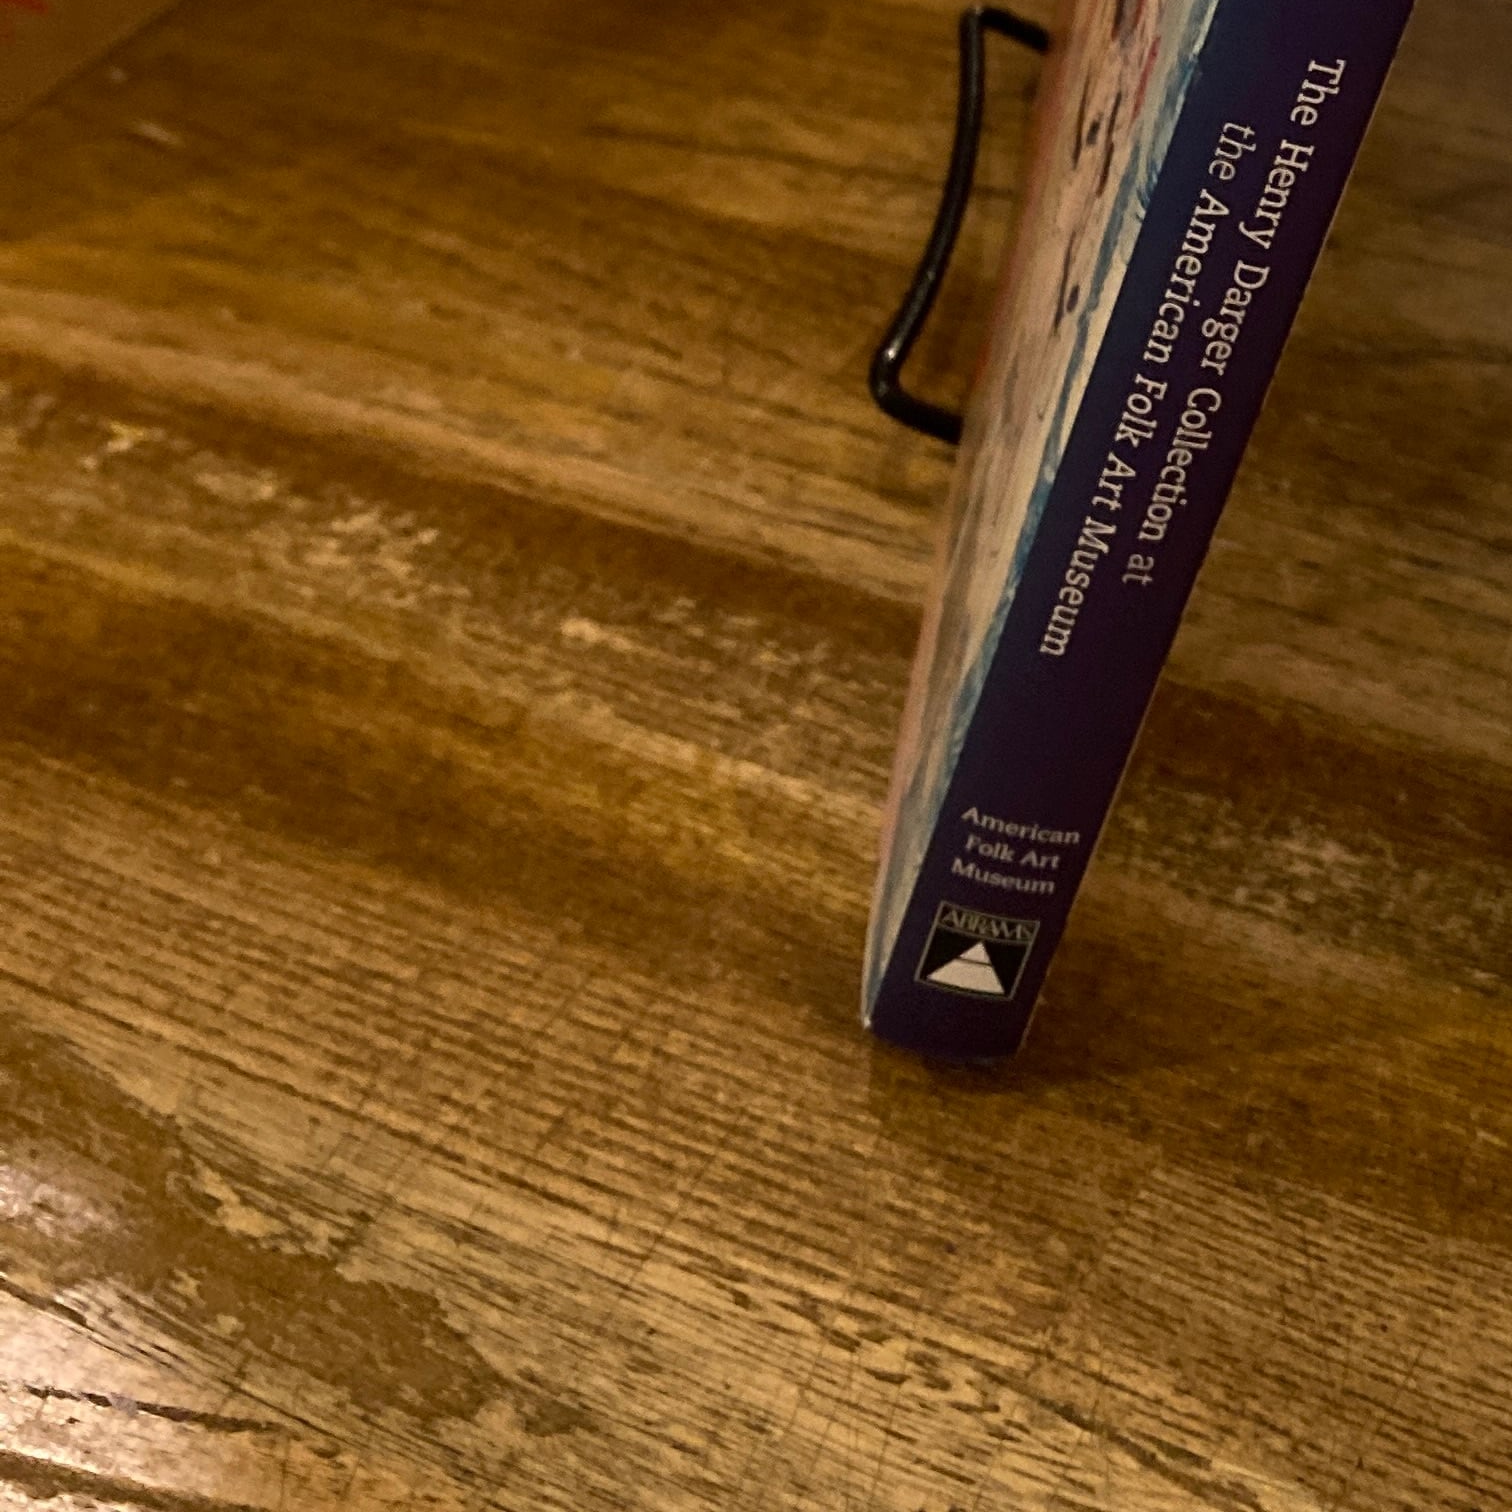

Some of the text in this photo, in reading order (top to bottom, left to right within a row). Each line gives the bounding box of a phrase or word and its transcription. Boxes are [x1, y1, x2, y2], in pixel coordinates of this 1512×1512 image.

[1122, 58, 1345, 586] The Henry Darger Collection at
[1039, 122, 1256, 657] the American Folk Art Museum
[961, 806, 1080, 844] American
[965, 834, 1060, 870] Folk Art
[952, 857, 1055, 895] Museum
[943, 907, 1033, 940] ABRAMS
